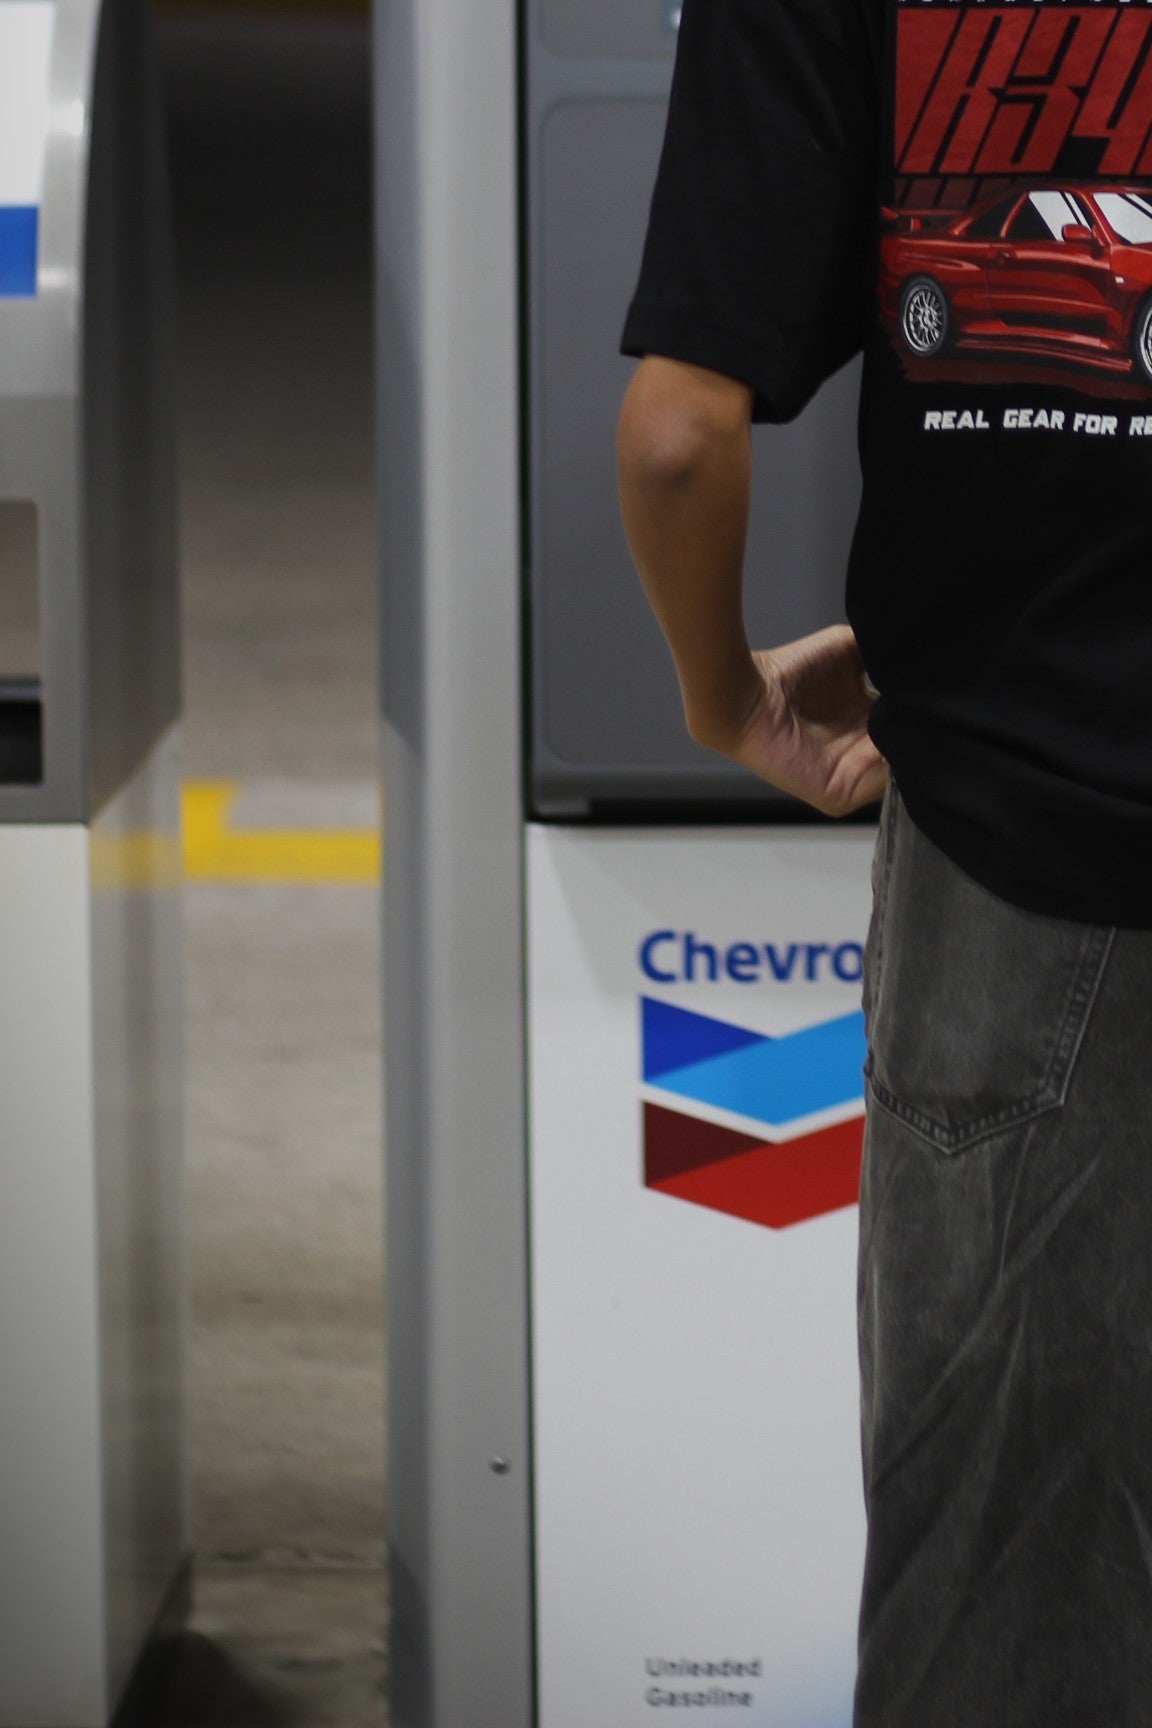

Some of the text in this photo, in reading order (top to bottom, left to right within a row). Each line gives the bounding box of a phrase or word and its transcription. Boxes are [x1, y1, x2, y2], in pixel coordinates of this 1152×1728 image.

[923, 408, 991, 432] REAL
[1002, 408, 1066, 432] GEAR
[1072, 412, 1119, 437] FOR
[640, 930, 864, 983] Chevro
[645, 1657, 763, 1677] Unleaded
[646, 1686, 754, 1708] Gasoline
